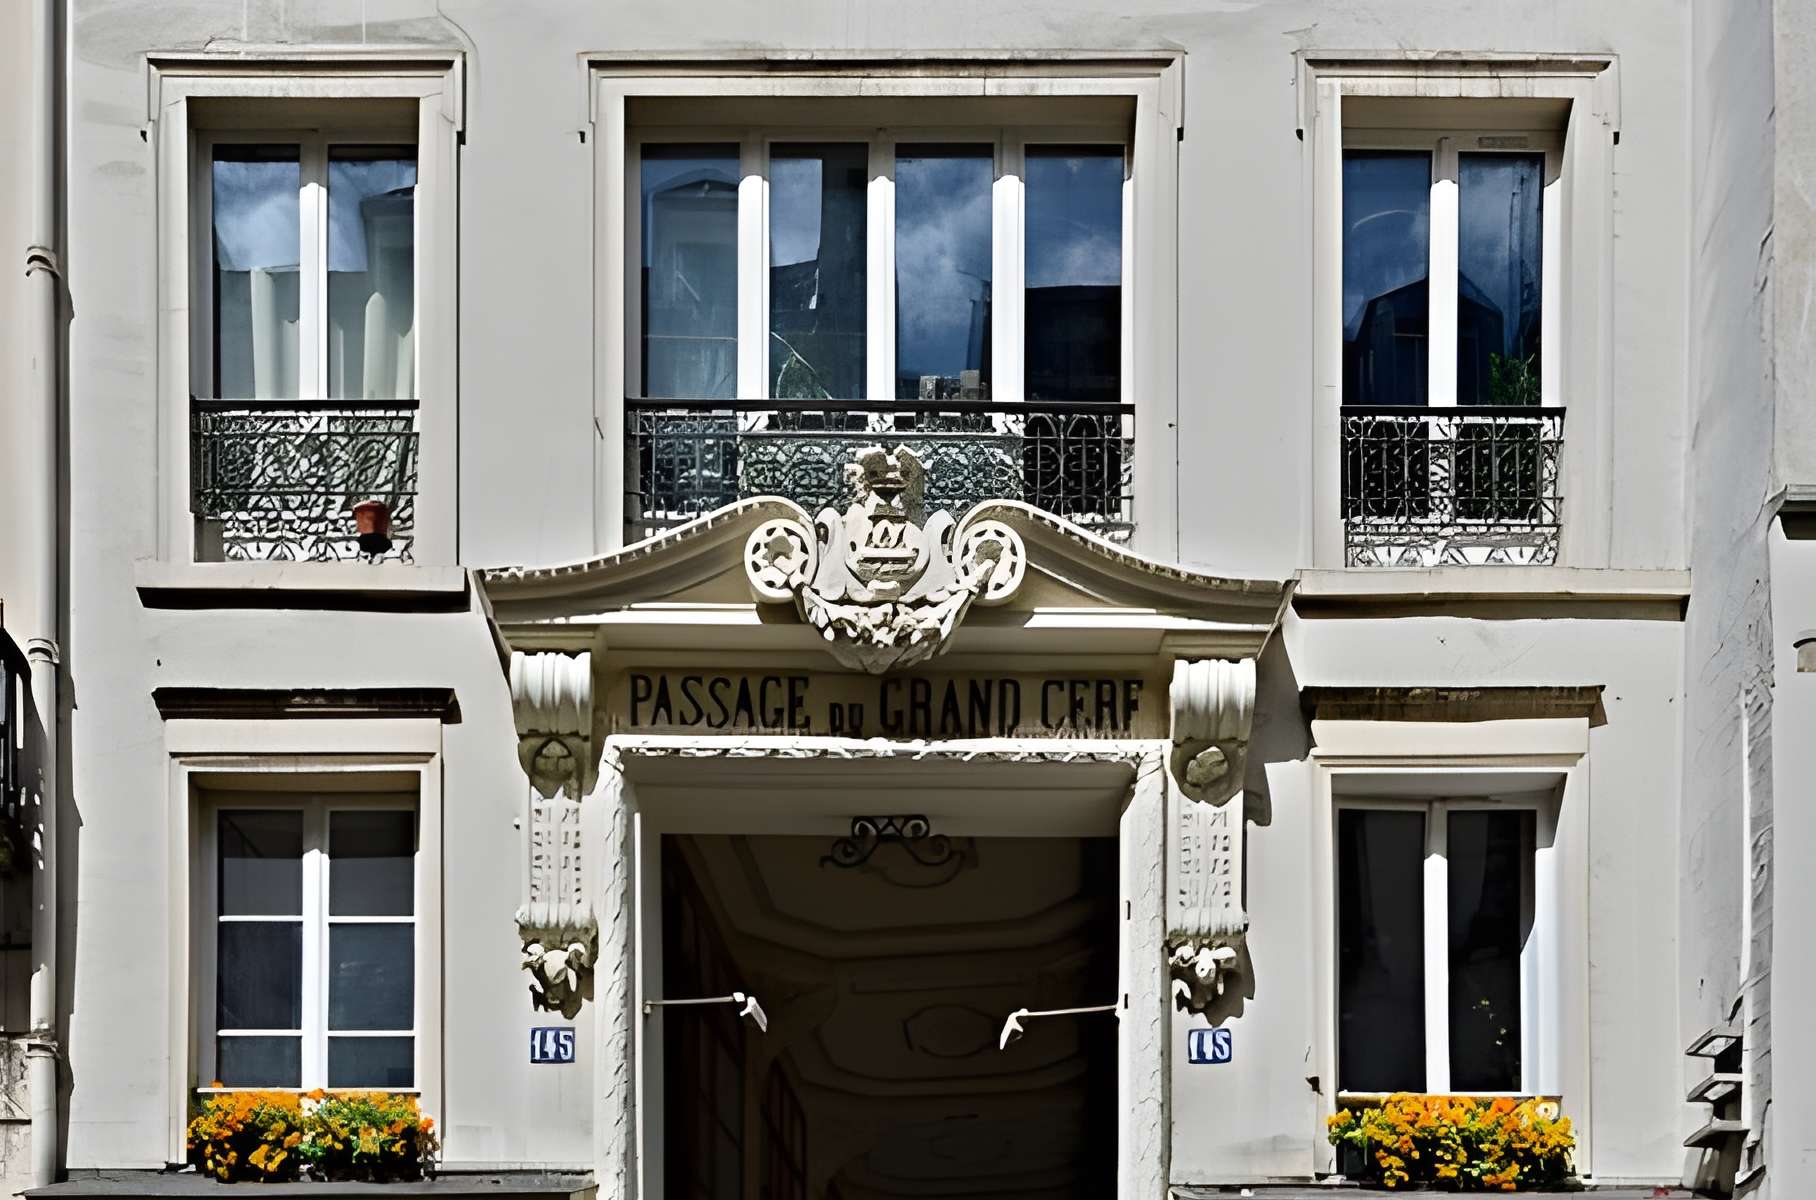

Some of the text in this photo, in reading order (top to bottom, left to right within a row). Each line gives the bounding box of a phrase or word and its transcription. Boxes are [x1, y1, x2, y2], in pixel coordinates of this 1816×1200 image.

[629, 674, 1144, 739] PASSAGE DU GRAND CERF
